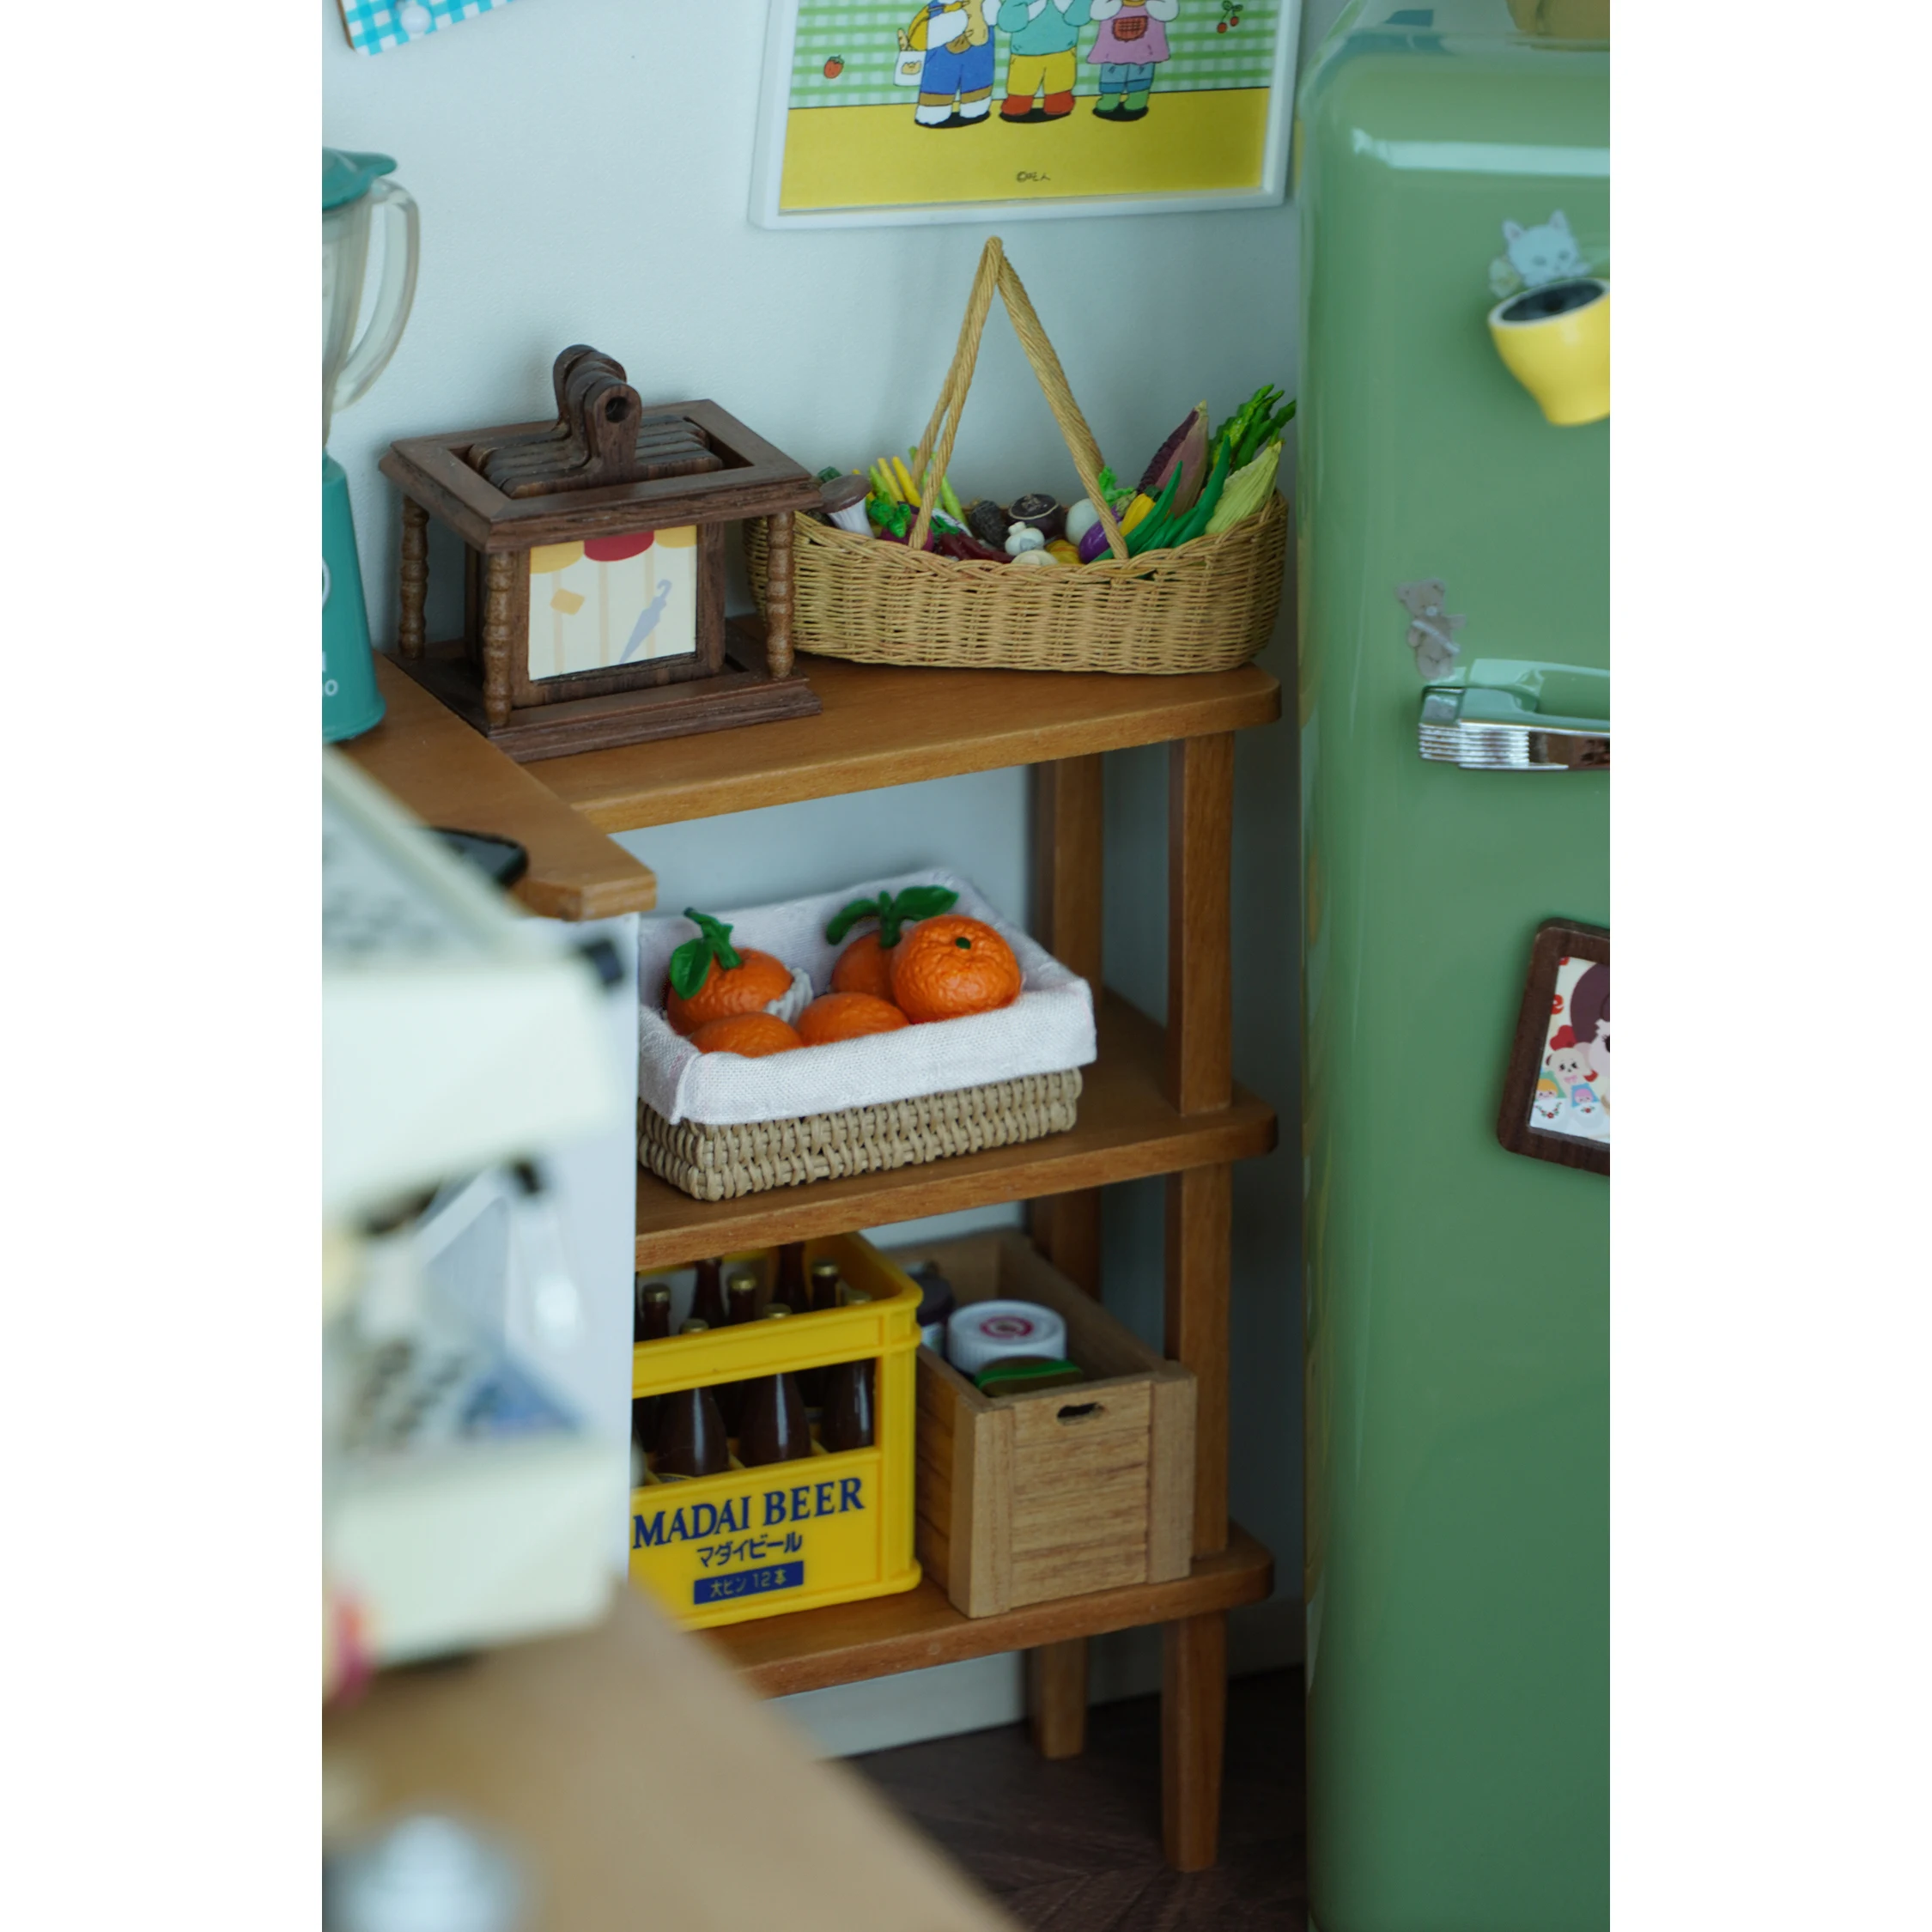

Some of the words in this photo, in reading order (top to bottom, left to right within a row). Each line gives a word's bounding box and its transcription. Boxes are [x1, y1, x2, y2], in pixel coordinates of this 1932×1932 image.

[633, 1496, 752, 1549] MADAI
[762, 1477, 865, 1526] BEER
[696, 1531, 803, 1568] マダイビール
